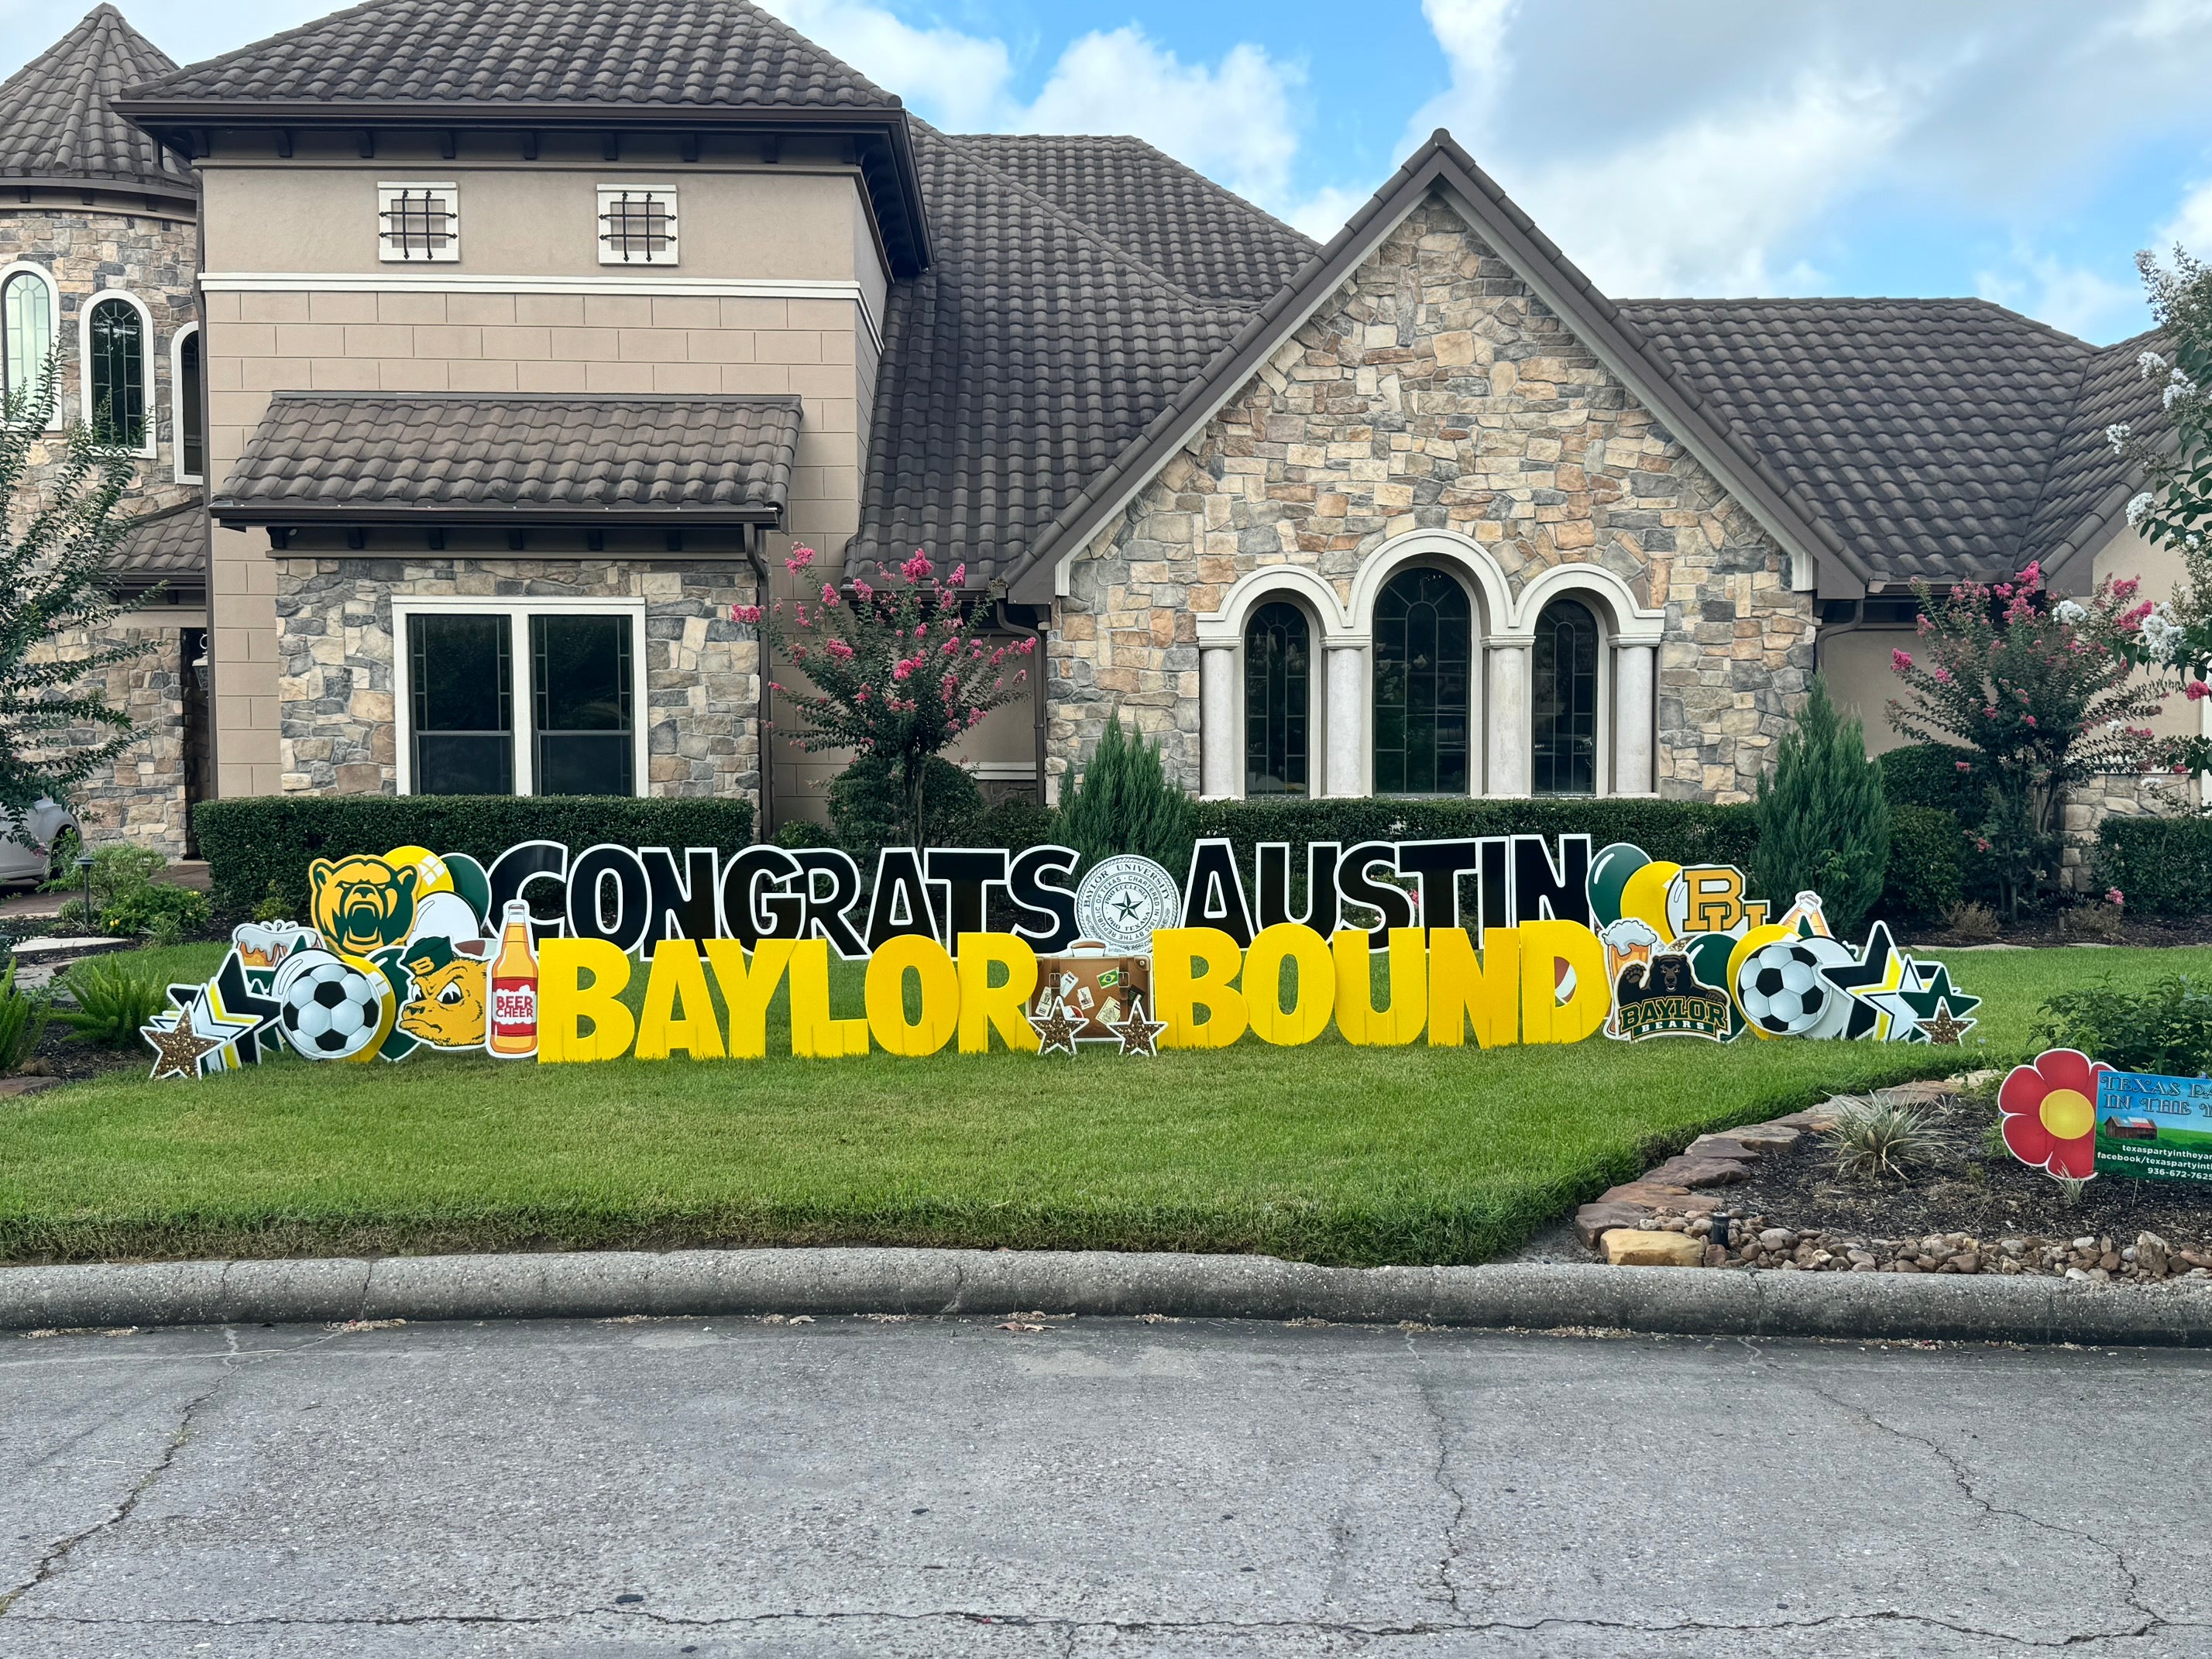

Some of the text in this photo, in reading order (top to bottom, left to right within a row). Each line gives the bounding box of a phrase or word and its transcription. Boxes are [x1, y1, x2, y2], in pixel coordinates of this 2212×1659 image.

[1084, 864, 1171, 908] BAYLOR UNIVERSITY
[1101, 877, 1122, 893] TEXAS
[1104, 884, 1149, 905] PRO ECCLESIA
[1128, 875, 1160, 907] CHARTERED
[486, 833, 1592, 961] CONGRATS AUSTIN
[1095, 894, 1102, 904] OF
[1095, 906, 1117, 938] REPUBLIC
[1107, 912, 1150, 931] PRO TEXANA
[1118, 933, 1133, 941] THE
[1135, 929, 1145, 939] BY
[409, 956, 434, 975] B
[496, 995, 533, 1008] BEER
[538, 921, 1613, 1063] BAYLOR BOUND
[496, 1008, 533, 1018] CHEER
[1620, 996, 1727, 1032] BAYLOR
[1642, 1020, 1705, 1033] BEARS
[2100, 1076, 2181, 1097] TEXAS
[2104, 1094, 2132, 1110] IN
[2139, 1097, 2192, 1115] THE
